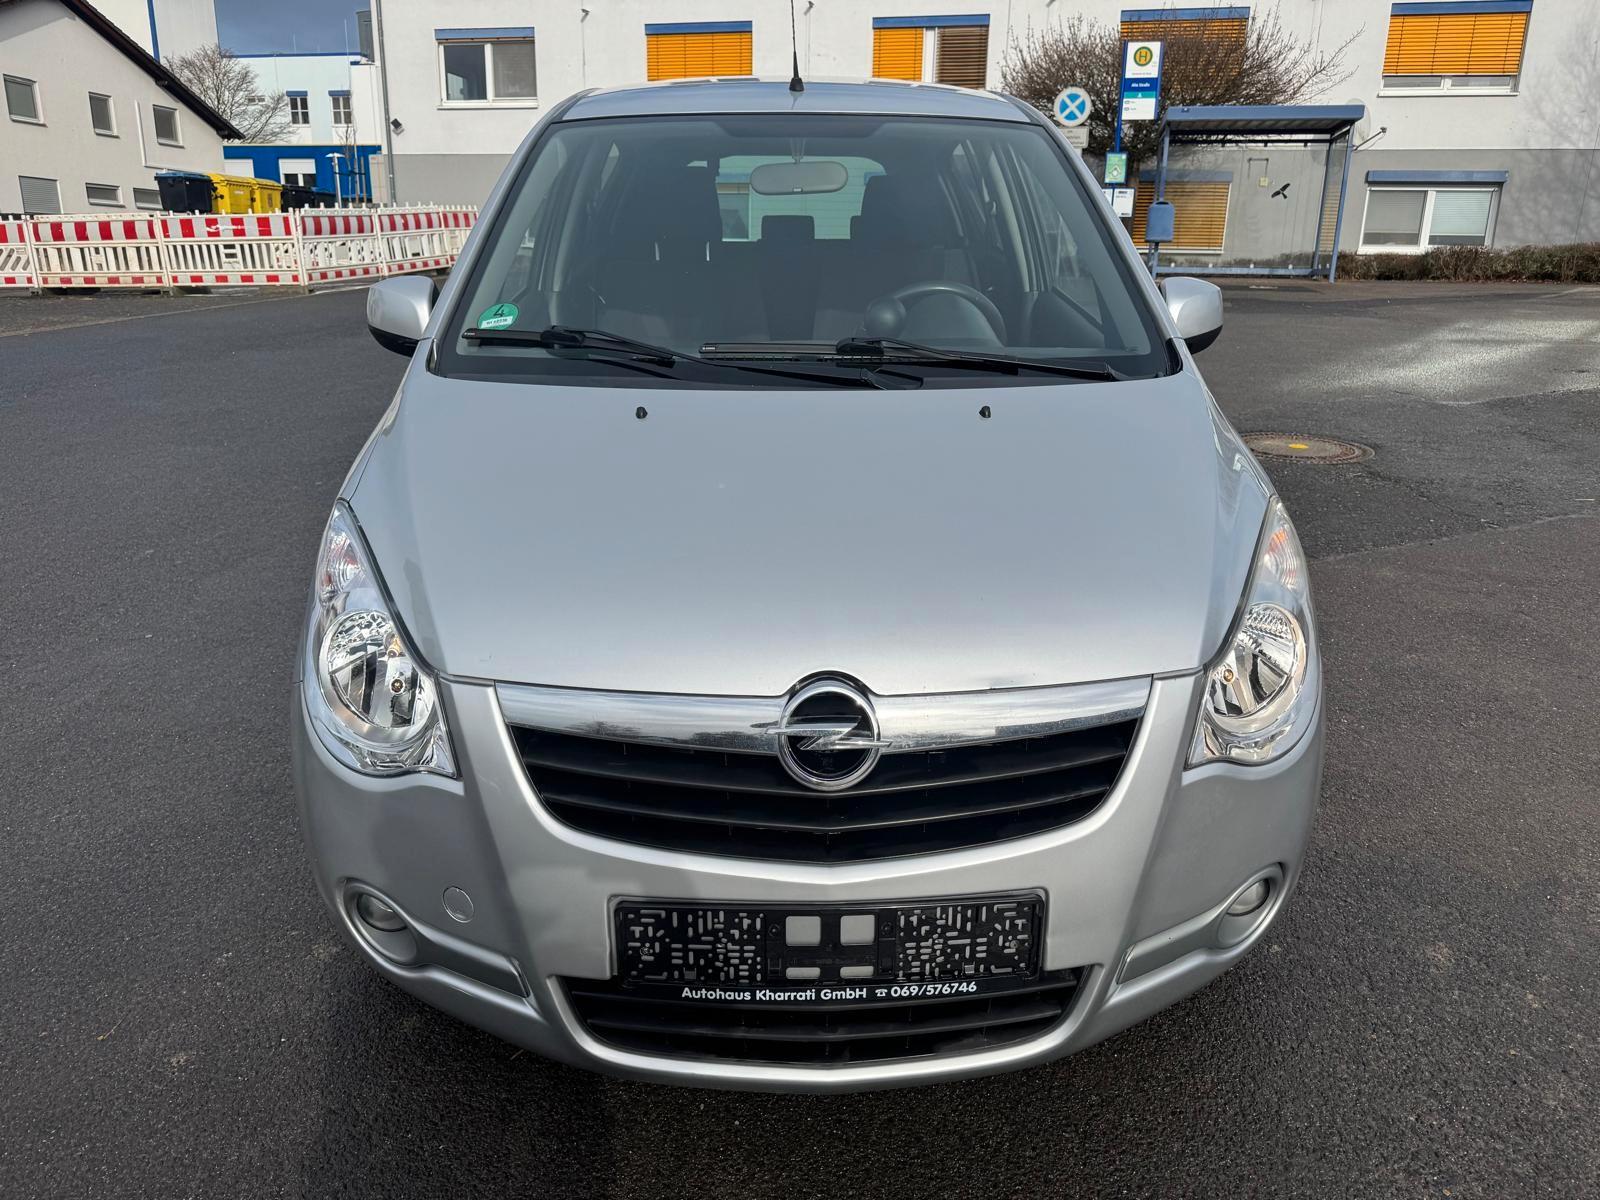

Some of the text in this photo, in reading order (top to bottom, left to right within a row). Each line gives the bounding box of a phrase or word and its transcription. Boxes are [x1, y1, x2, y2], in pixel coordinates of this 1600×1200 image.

[1139, 51, 1148, 62] H
[493, 304, 505, 317] 4
[681, 981, 977, 1001] Autohaus Kharrati GmbH 069/576746
